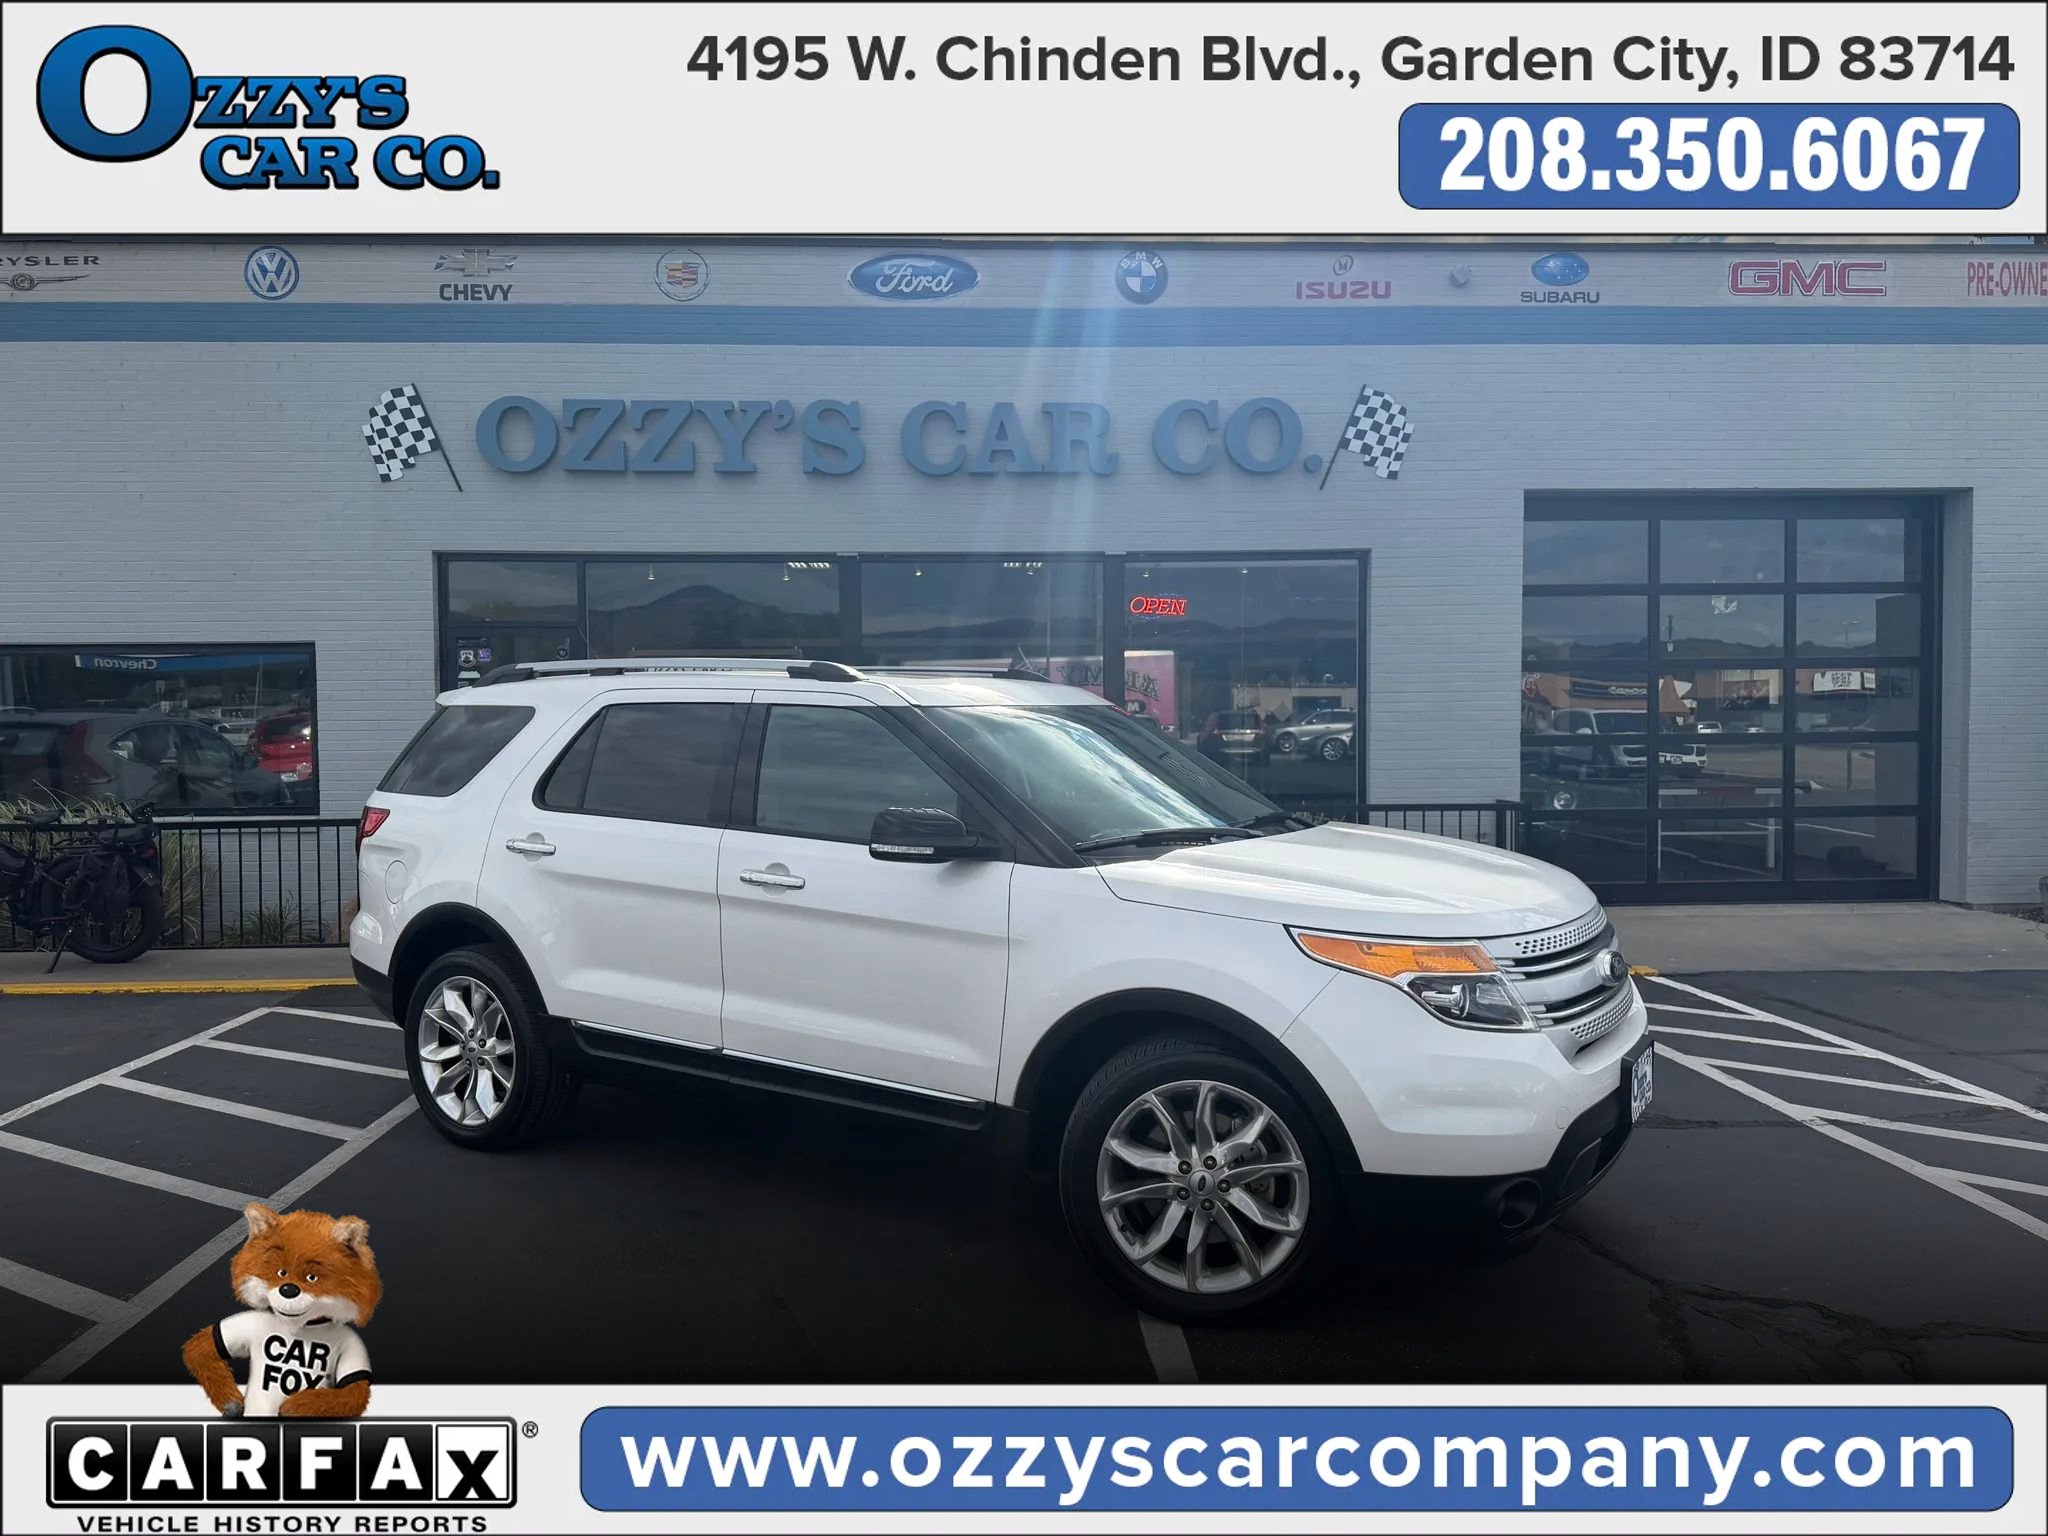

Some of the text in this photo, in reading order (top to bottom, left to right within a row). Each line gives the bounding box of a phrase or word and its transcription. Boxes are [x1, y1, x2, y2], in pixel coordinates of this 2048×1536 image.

[0, 255, 100, 267] YSLER
[875, 258, 955, 293] Ford
[1729, 260, 1886, 296] GMC
[439, 283, 513, 301] CHEVY
[1296, 281, 1391, 300] ISUZU
[1520, 291, 1600, 303] SUBARU
[476, 395, 1323, 476] OZZY'S CAR CO.
[1129, 596, 1188, 616] OPEN
